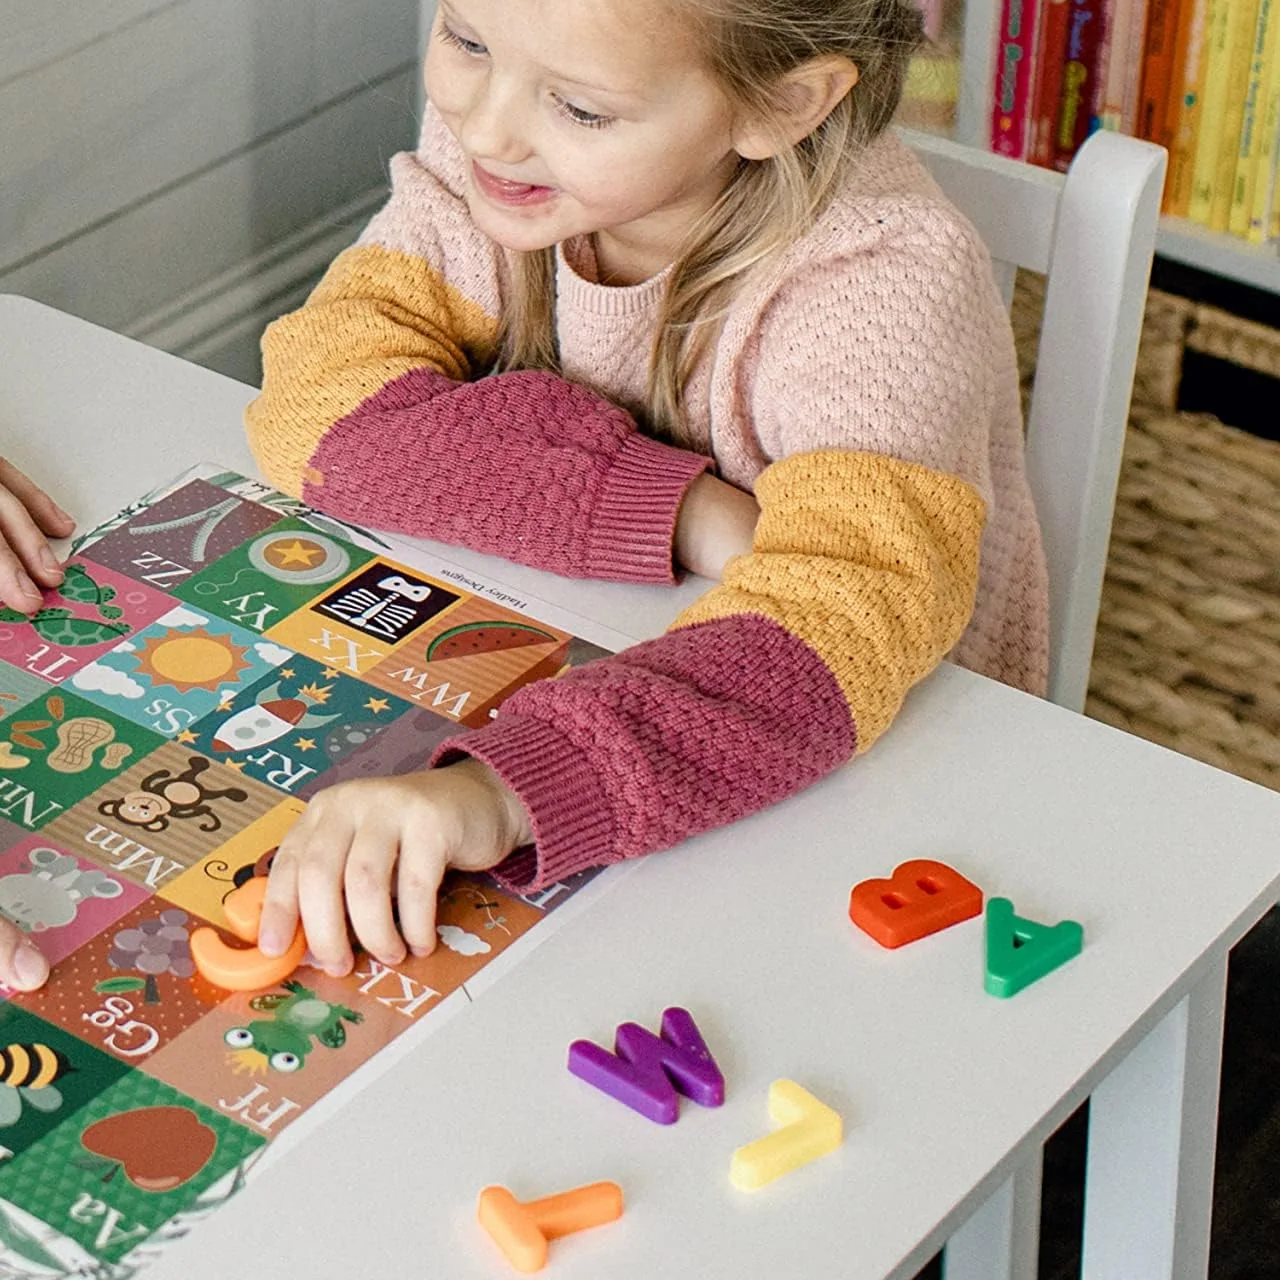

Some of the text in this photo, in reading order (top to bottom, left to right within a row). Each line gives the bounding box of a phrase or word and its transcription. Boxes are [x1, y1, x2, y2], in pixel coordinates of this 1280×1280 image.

[131, 551, 193, 588] Zz
[441, 569, 527, 609] Hadley Designs
[222, 590, 280, 632] Yy
[27, 644, 78, 683] Tt
[307, 627, 383, 674] Xx
[144, 697, 198, 734] Ss
[388, 665, 473, 720] Ww
[247, 749, 317, 795] Rr
[84, 822, 186, 889] Mm
[355, 959, 442, 1018] Kk
[82, 995, 159, 1059] Gg
[220, 1083, 301, 1133] Ff
[68, 1192, 148, 1249] Aa
